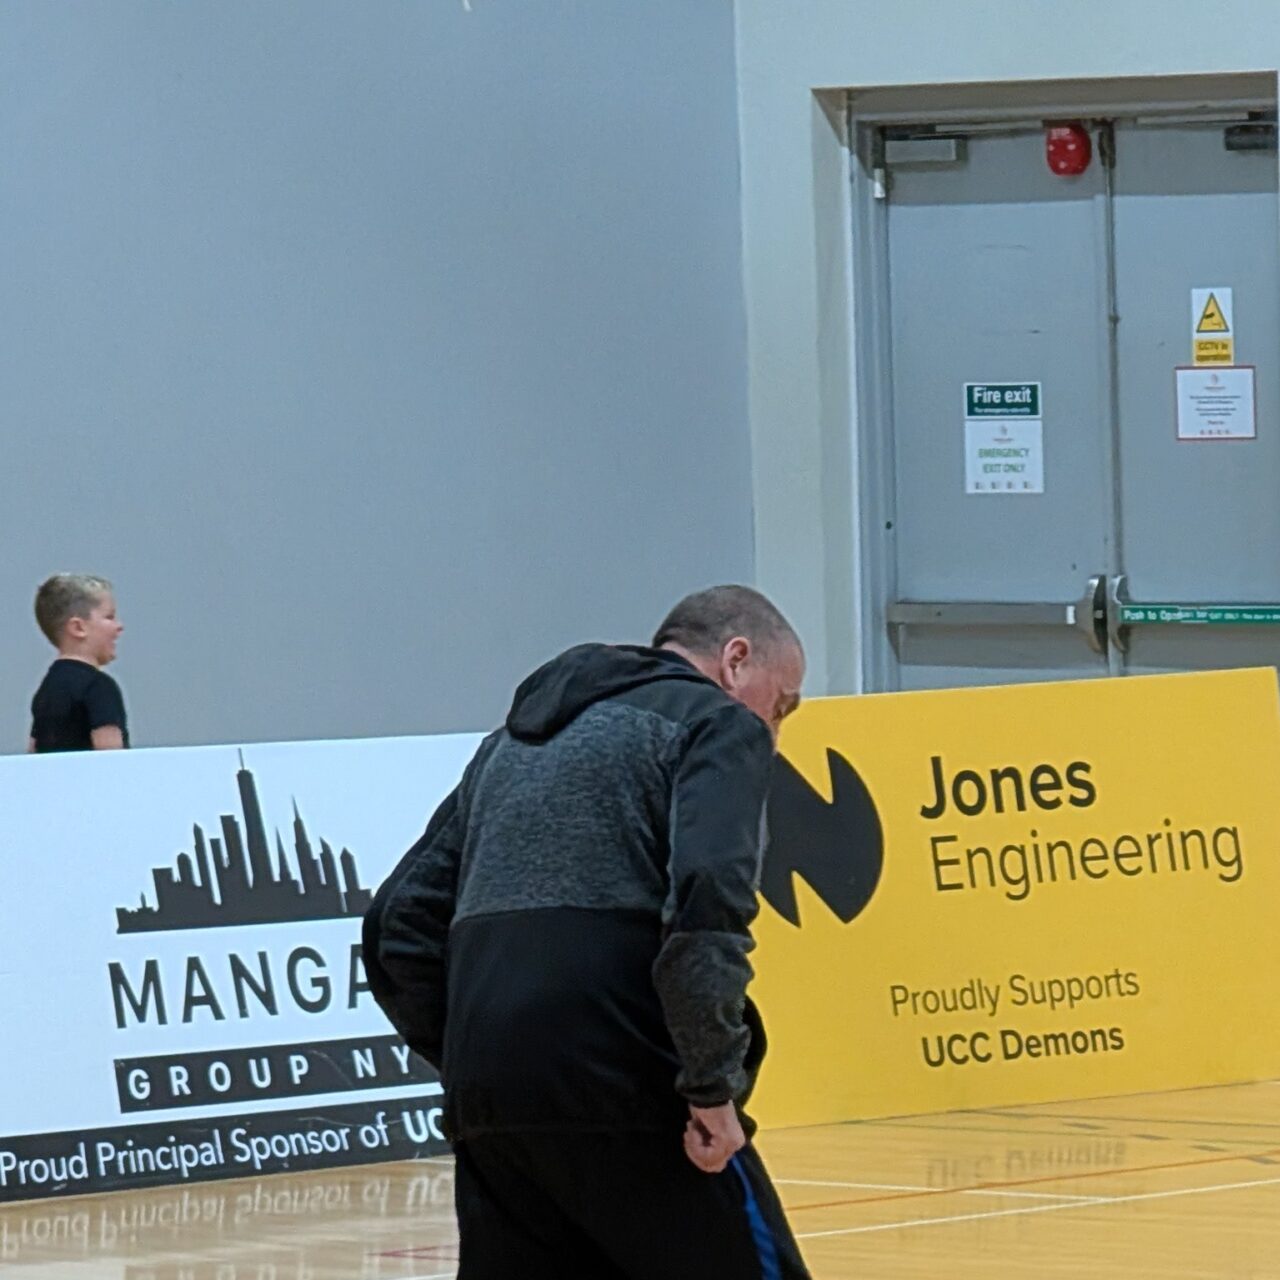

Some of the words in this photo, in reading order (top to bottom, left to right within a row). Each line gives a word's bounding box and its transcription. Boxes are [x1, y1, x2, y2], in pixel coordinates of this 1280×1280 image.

[973, 387, 1001, 403] Fire
[1004, 386, 1032, 403] exit
[978, 448, 1029, 459] EMERGENCY
[1003, 464, 1025, 473] ONLY
[1123, 610, 1145, 620] Push
[1147, 610, 1157, 620] to
[920, 756, 1097, 819] Jones
[930, 818, 1243, 900] Engineering
[108, 943, 373, 1029] MANGA
[890, 978, 1000, 1016] Proudly
[1009, 968, 1139, 1010] Supports
[921, 1031, 992, 1067] UCC
[1000, 1026, 1124, 1060] Demons
[128, 1054, 309, 1100] GROUP
[352, 1044, 410, 1078] NY
[0, 1141, 88, 1187] Proud
[96, 1128, 225, 1178] Principal
[230, 1127, 350, 1170] Sponsor
[360, 1111, 389, 1148] of
[402, 1107, 446, 1143] UC
